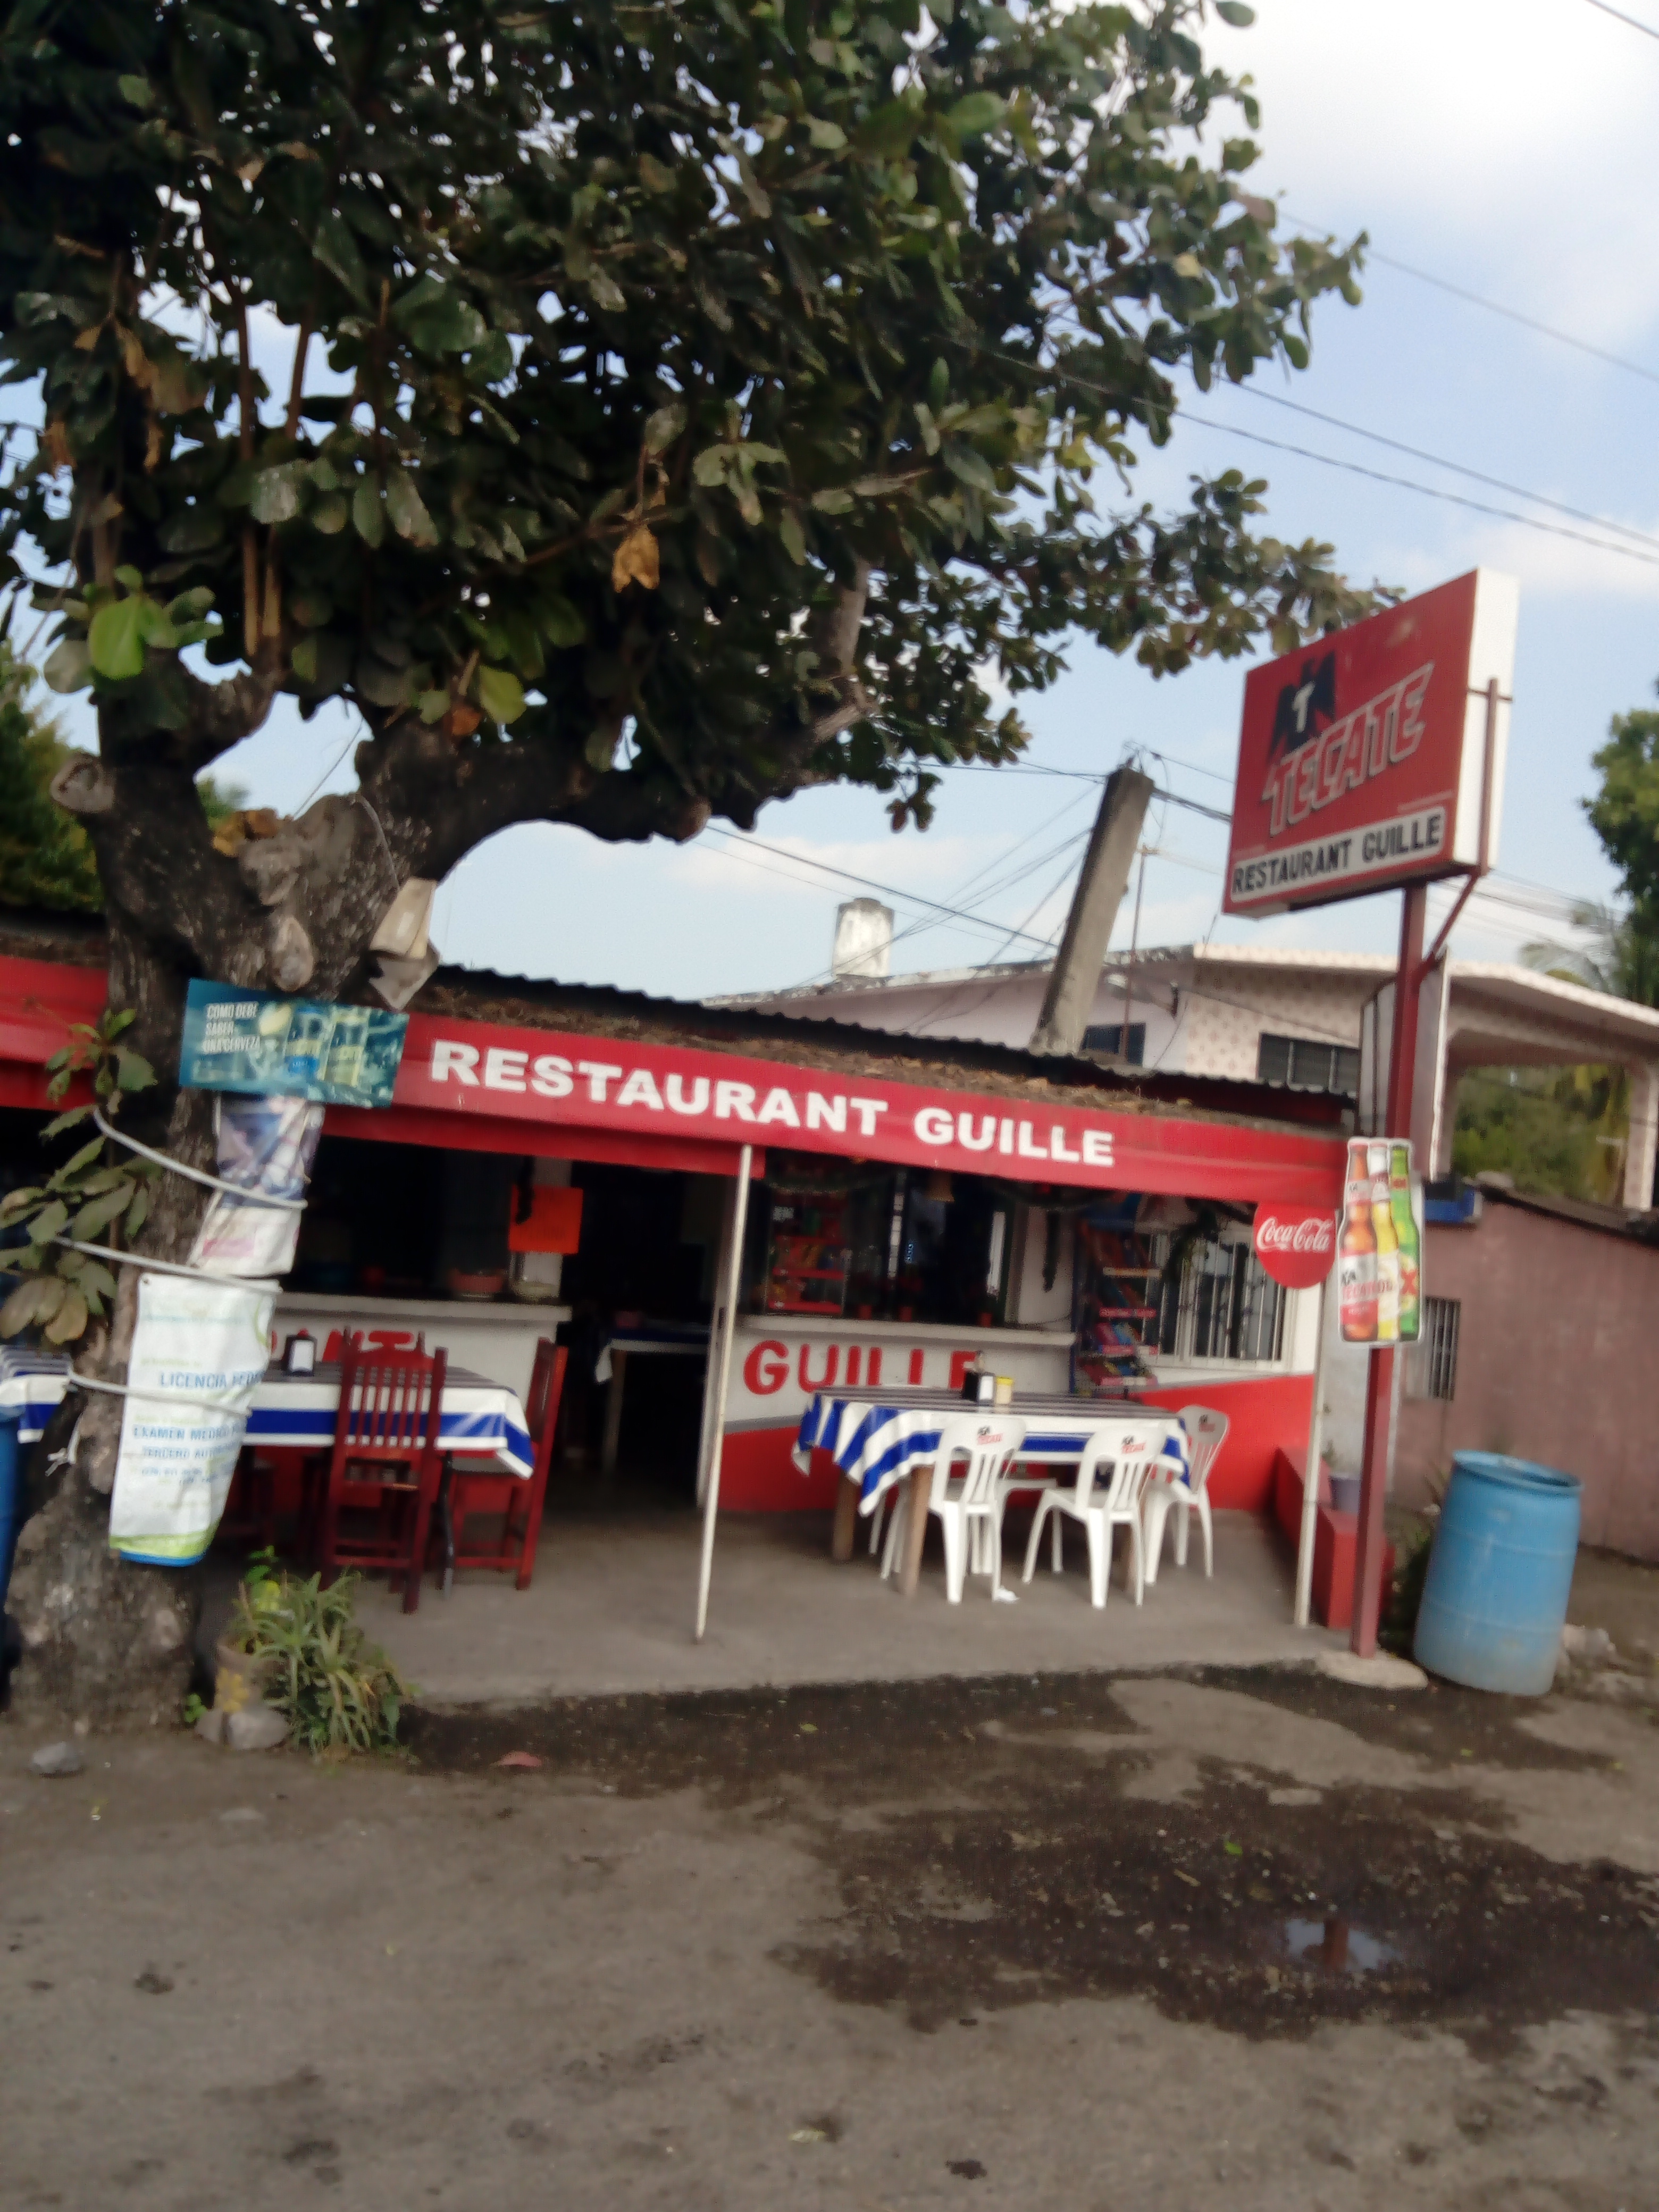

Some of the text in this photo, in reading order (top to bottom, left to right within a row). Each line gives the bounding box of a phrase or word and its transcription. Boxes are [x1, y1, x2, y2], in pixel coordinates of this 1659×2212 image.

[1232, 814, 1441, 894] RESTAURANT GUILLE
[430, 1038, 1115, 1167] RESTAURANT GUILLE
[1256, 1217, 1334, 1253] Coca-Cola
[161, 1370, 227, 1389] LICENCIA
